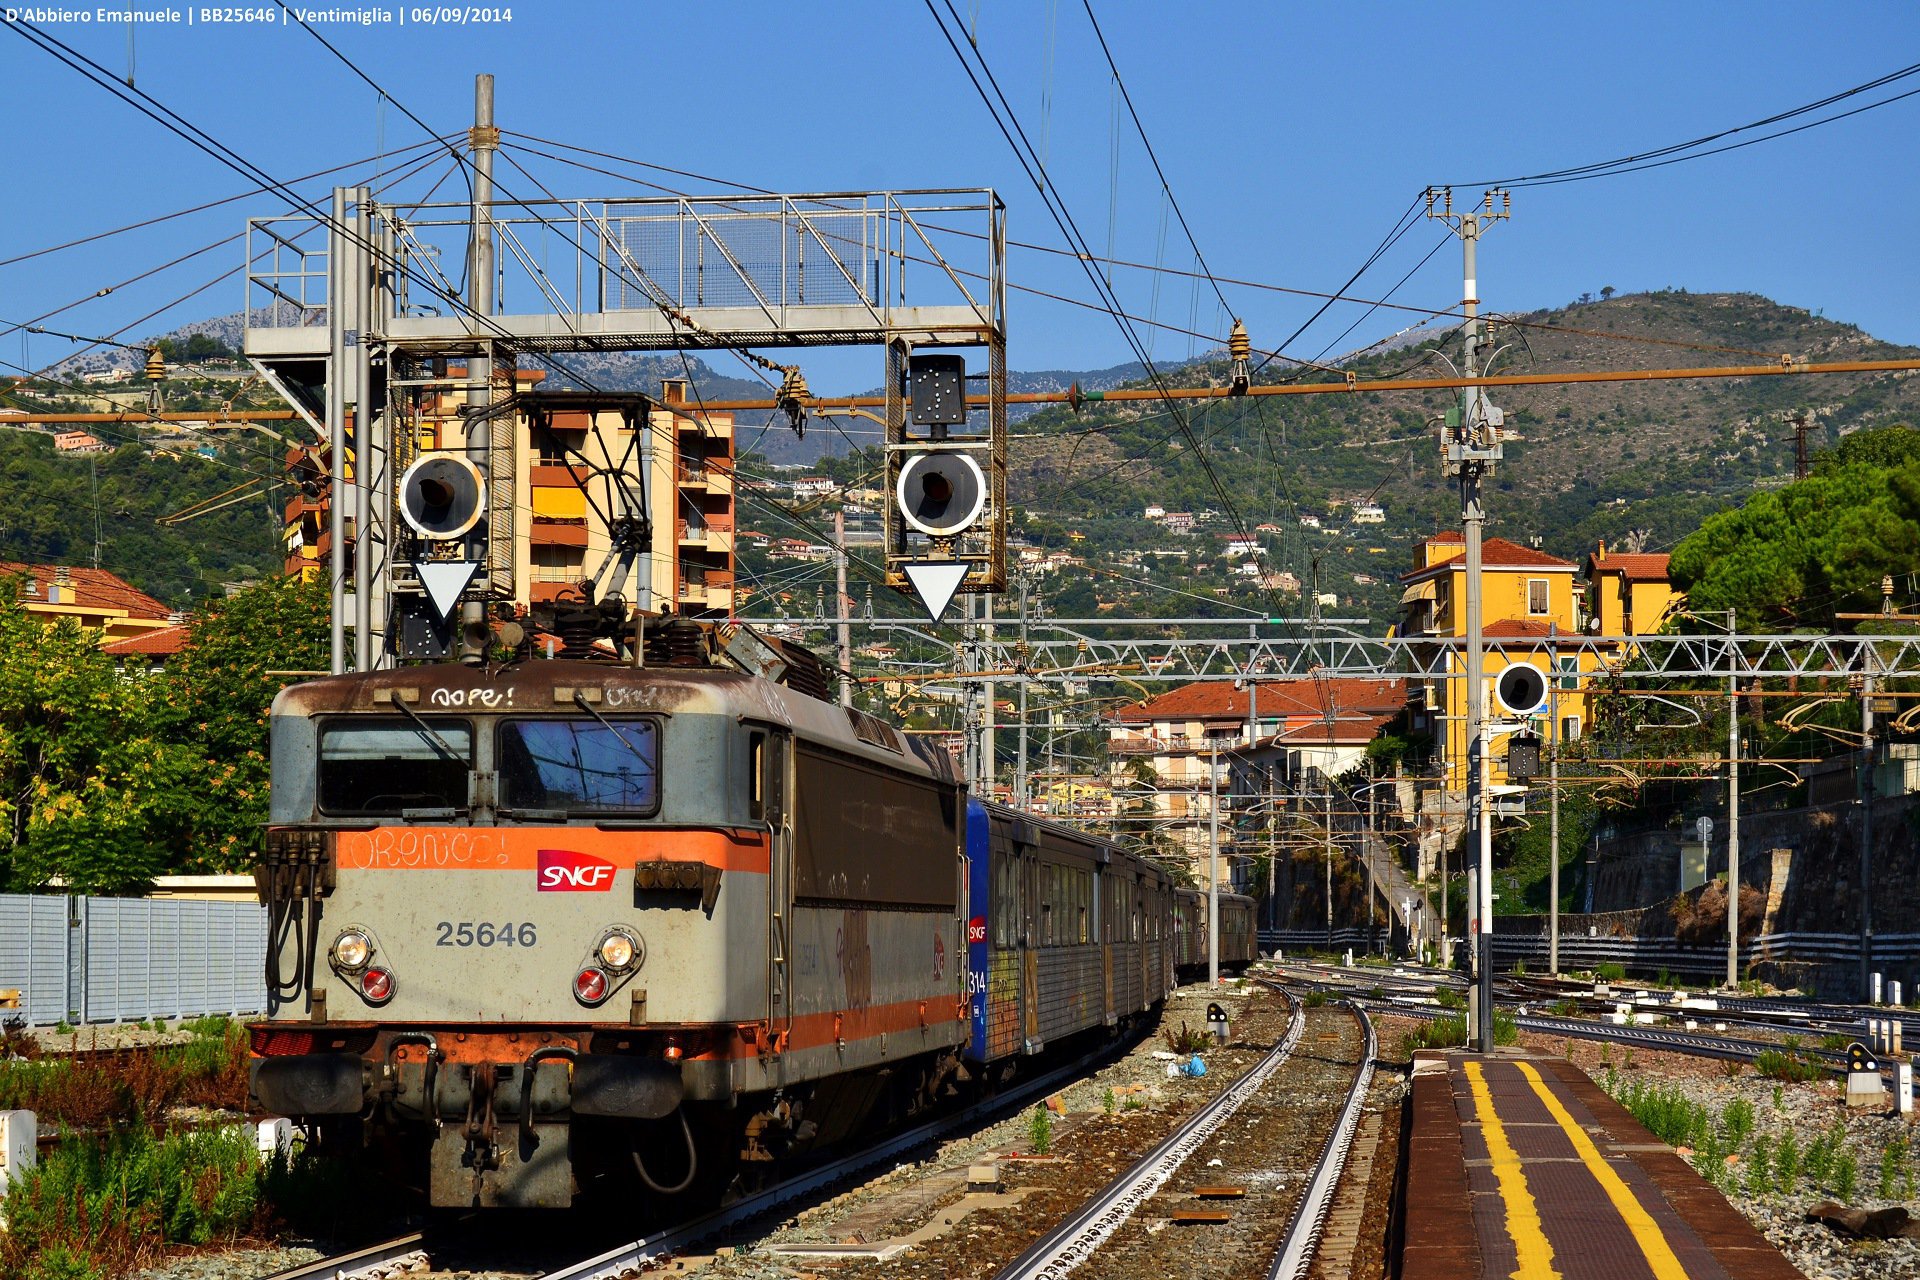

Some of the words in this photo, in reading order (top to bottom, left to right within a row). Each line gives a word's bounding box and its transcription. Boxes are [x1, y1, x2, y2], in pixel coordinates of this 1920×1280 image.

[541, 866, 613, 887] SNCF
[437, 922, 536, 947] 25646
[969, 926, 986, 939] SNCF
